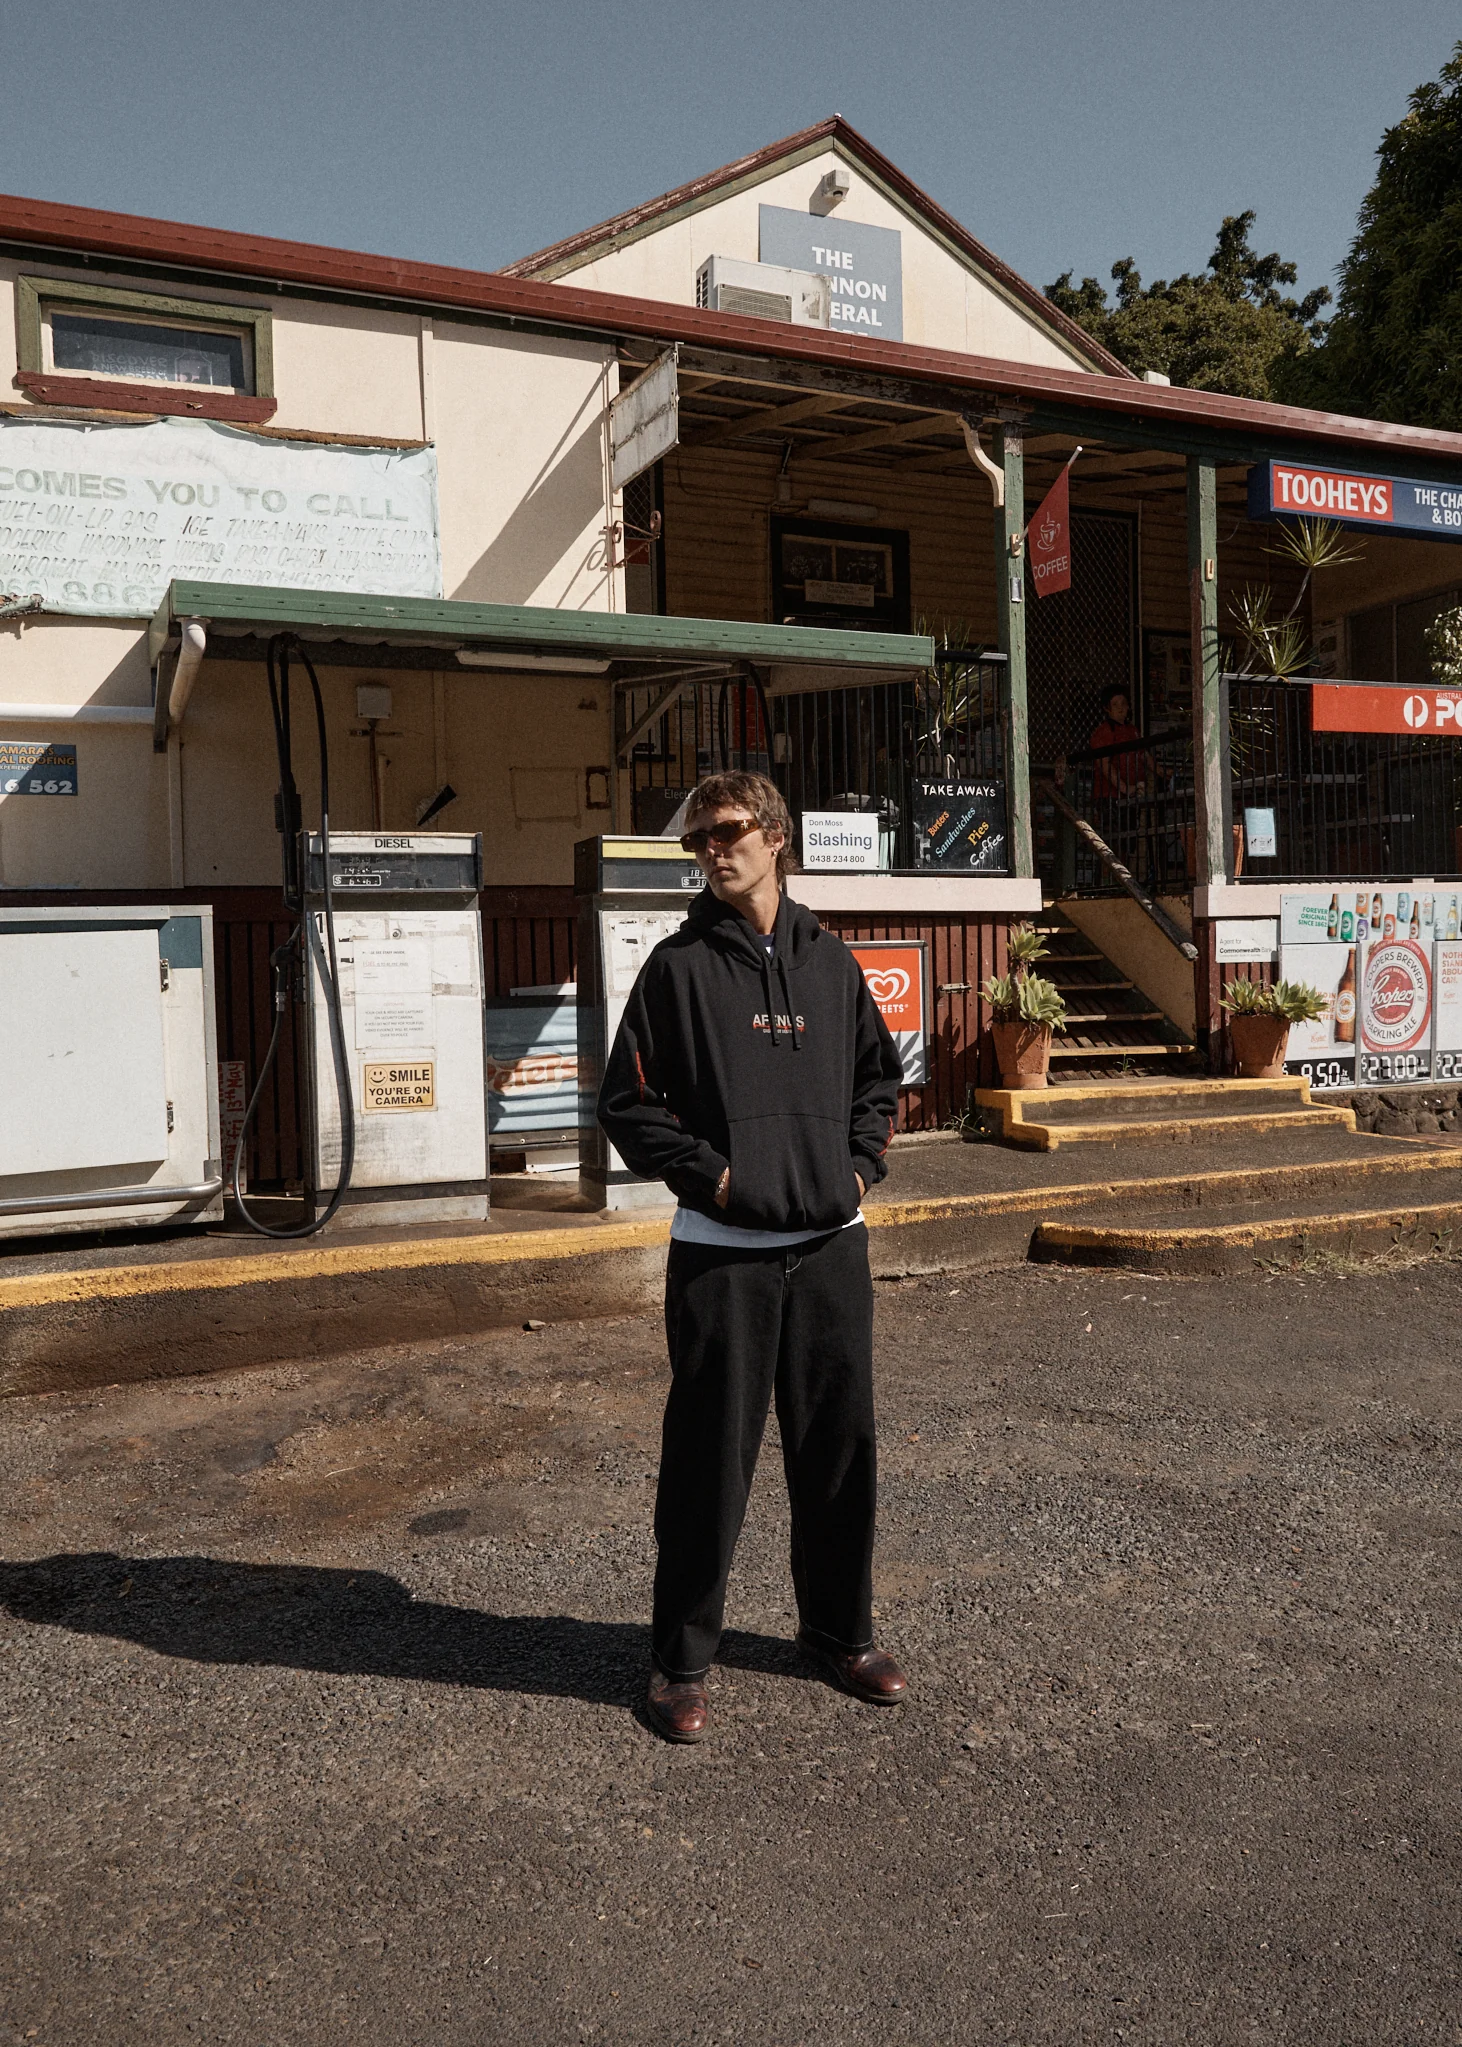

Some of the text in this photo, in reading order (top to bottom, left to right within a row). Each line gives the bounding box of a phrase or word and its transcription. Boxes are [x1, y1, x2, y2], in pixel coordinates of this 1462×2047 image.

[811, 246, 853, 270] THE
[144, 479, 220, 509] YOU
[236, 486, 288, 514] TO
[306, 493, 409, 522] CALL
[1277, 471, 1388, 515] TOOHEYS
[1414, 487, 1438, 507] THE
[119, 510, 159, 534] GAS
[181, 515, 214, 537] ICE
[1431, 508, 1462, 527] & BO
[1032, 555, 1068, 580] COFFEE
[18, 756, 75, 765] ROOFING
[29, 780, 73, 794] 562
[922, 784, 954, 796] TAKE
[808, 832, 872, 850] Slashing
[935, 807, 976, 858] Sandwiches
[967, 821, 990, 846] Pies
[374, 838, 414, 849] DIESEL
[969, 834, 1005, 866] Coffee
[809, 855, 865, 863] 0438 234 800
[1300, 913, 1327, 921] ORIGINAL
[1302, 907, 1328, 915] FOREVER
[1219, 938, 1235, 946] Agent
[1366, 952, 1424, 990] COOPERS BREWERY
[1365, 1014, 1418, 1039] SPARKLING ALE
[226, 1062, 245, 1089] May
[389, 1069, 430, 1082] SMILE
[369, 1086, 431, 1096] YOU'RE ON
[375, 1096, 423, 1105] CAMERA
